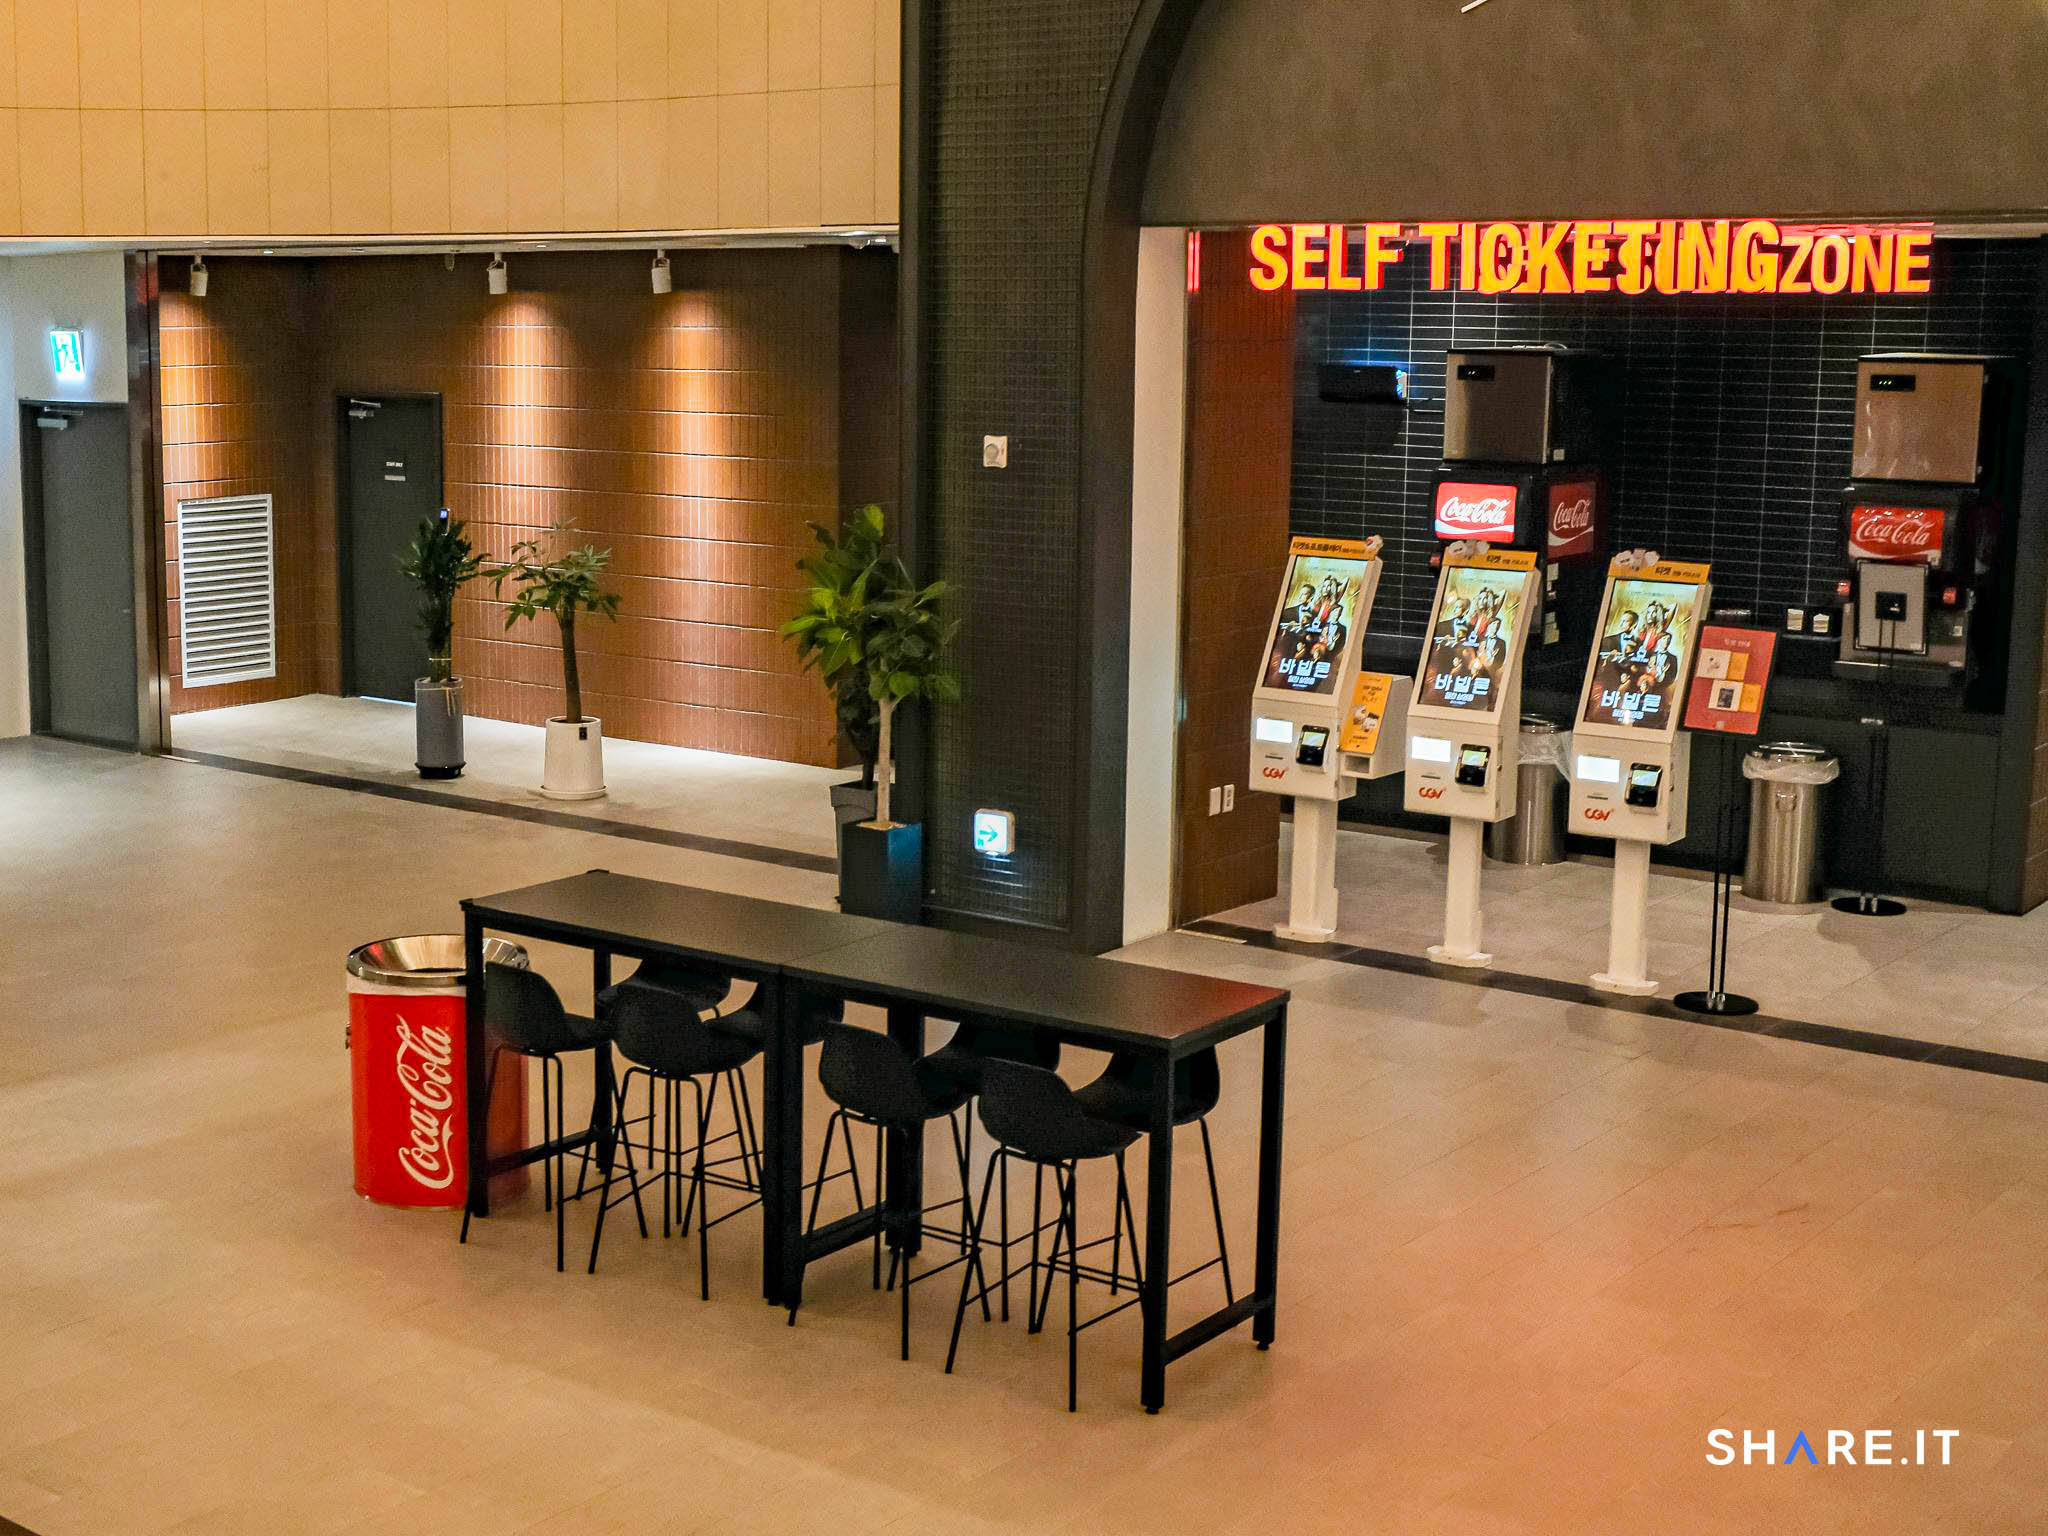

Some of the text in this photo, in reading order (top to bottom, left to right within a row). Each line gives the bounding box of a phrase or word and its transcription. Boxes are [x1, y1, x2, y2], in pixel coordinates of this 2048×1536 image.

[1249, 223, 1402, 291] SELF
[1419, 221, 1779, 293] TICKETING
[1779, 232, 1933, 294] ZONE
[1262, 766, 1287, 780] CGV
[1418, 786, 1444, 800] CGV
[1583, 807, 1611, 821] CGV
